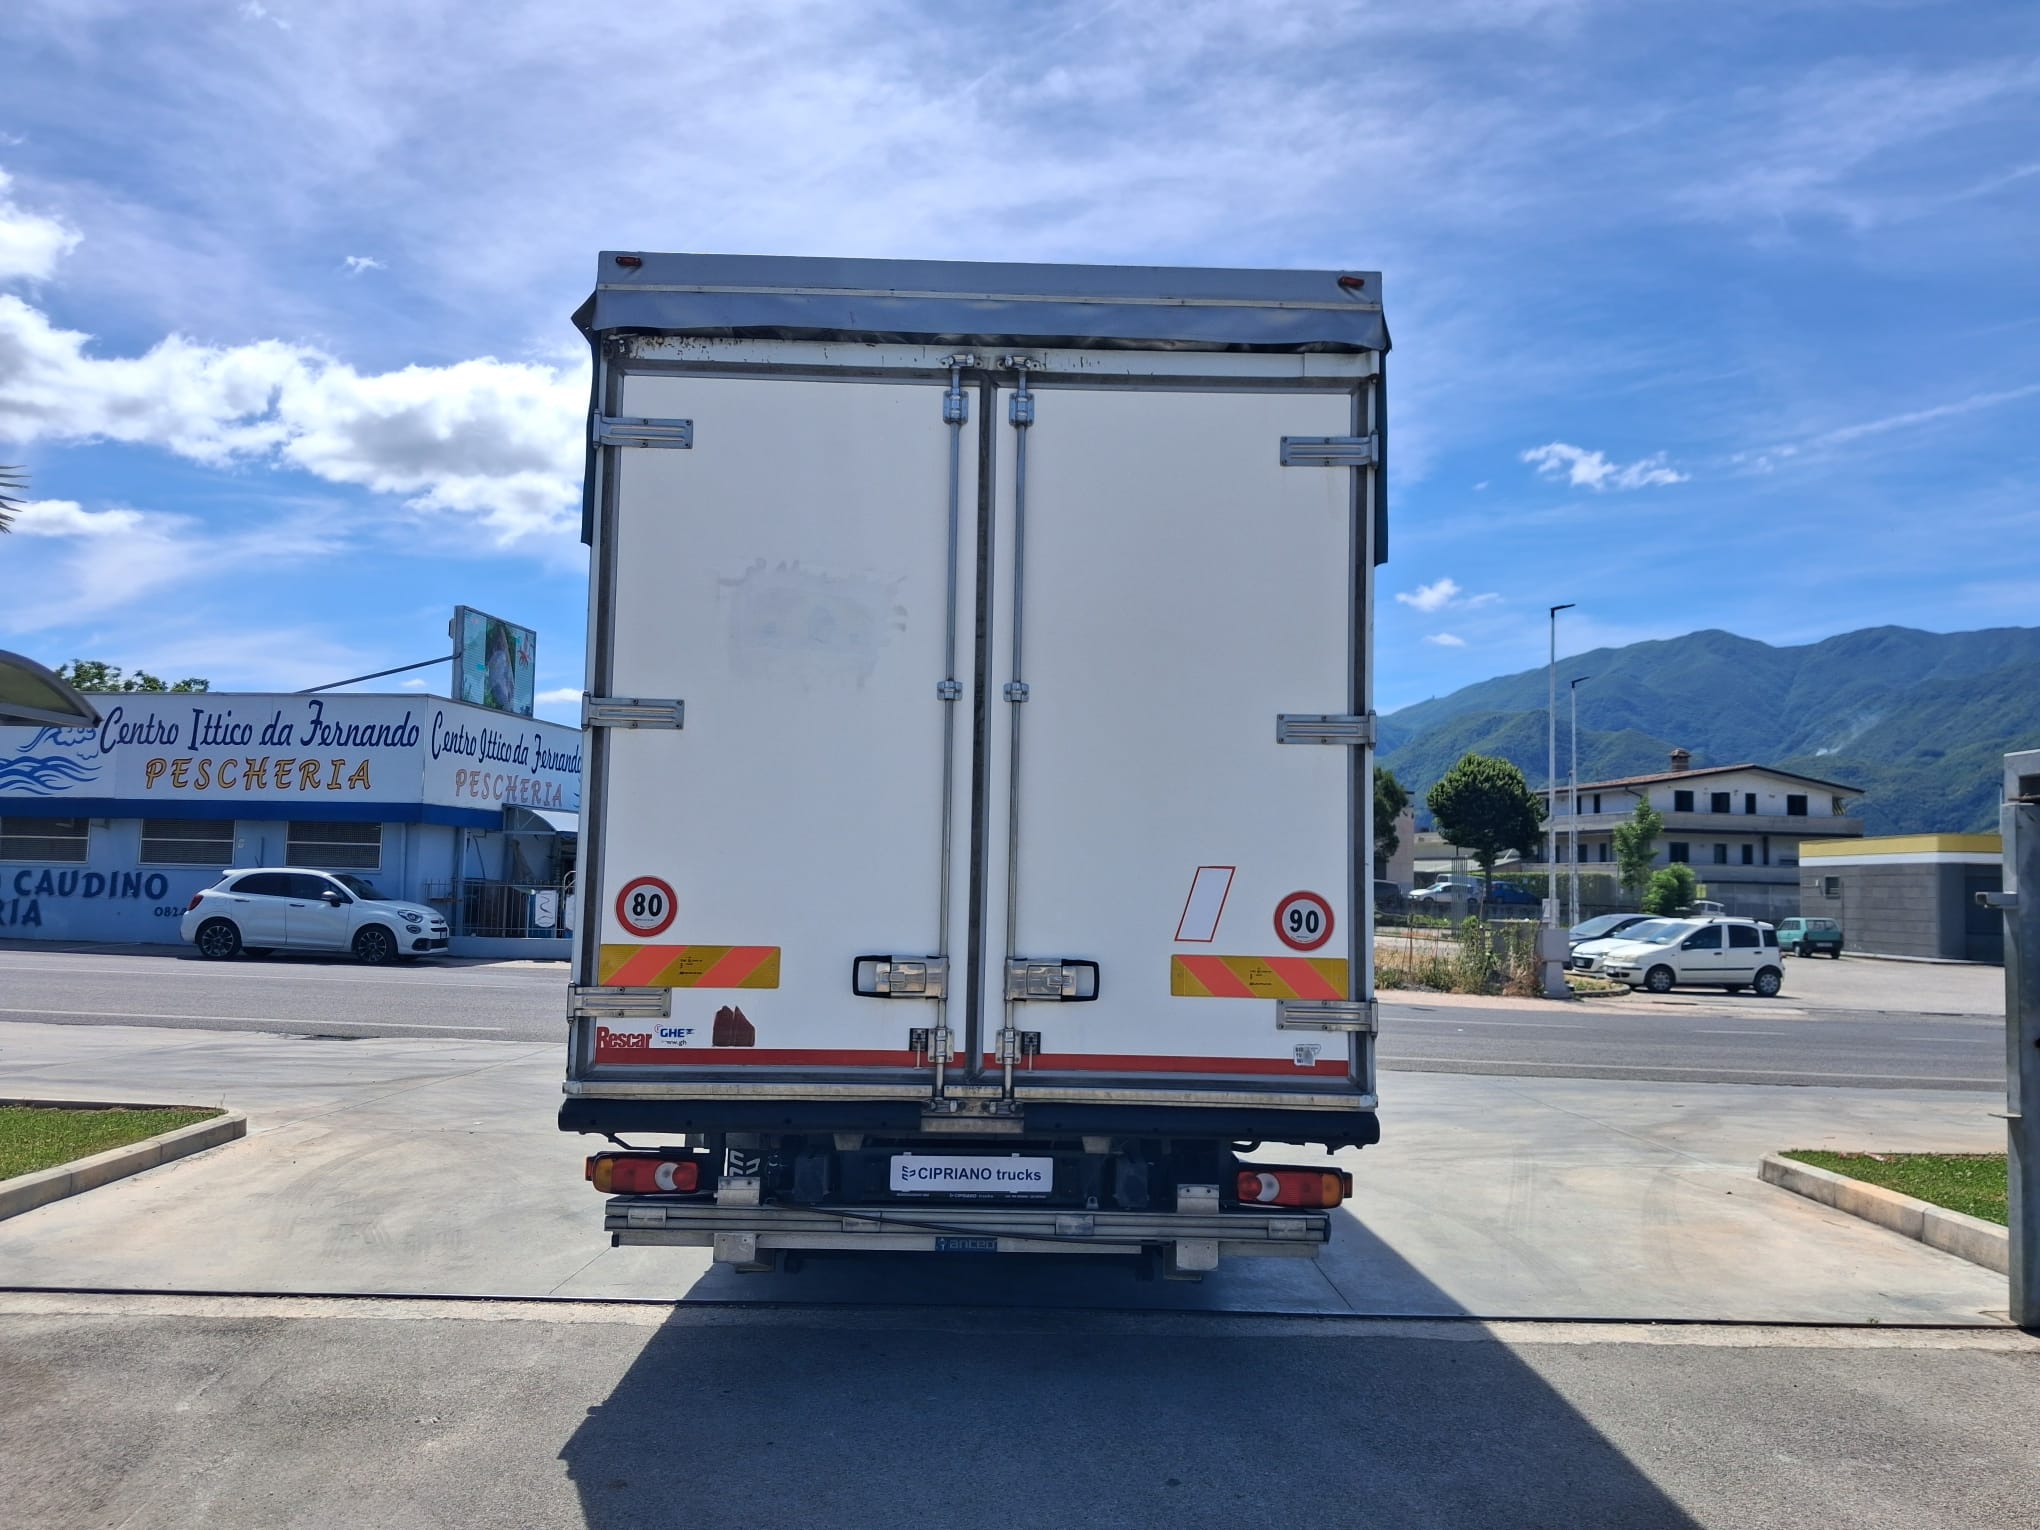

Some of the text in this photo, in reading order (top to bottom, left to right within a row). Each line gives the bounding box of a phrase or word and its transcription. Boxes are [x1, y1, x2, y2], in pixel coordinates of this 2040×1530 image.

[100, 699, 419, 754] Centro Ittico da Fernando
[431, 711, 477, 760] Centro
[511, 733, 530, 766] da
[145, 756, 371, 791] PESCHERIA
[455, 769, 562, 807] PESCHERIA
[14, 869, 168, 900] CAUDINO
[632, 892, 663, 917] 80
[1289, 908, 1319, 934] 90
[597, 1026, 652, 1048] Rescar
[918, 1167, 1042, 1181] CIPRIANO trucks
